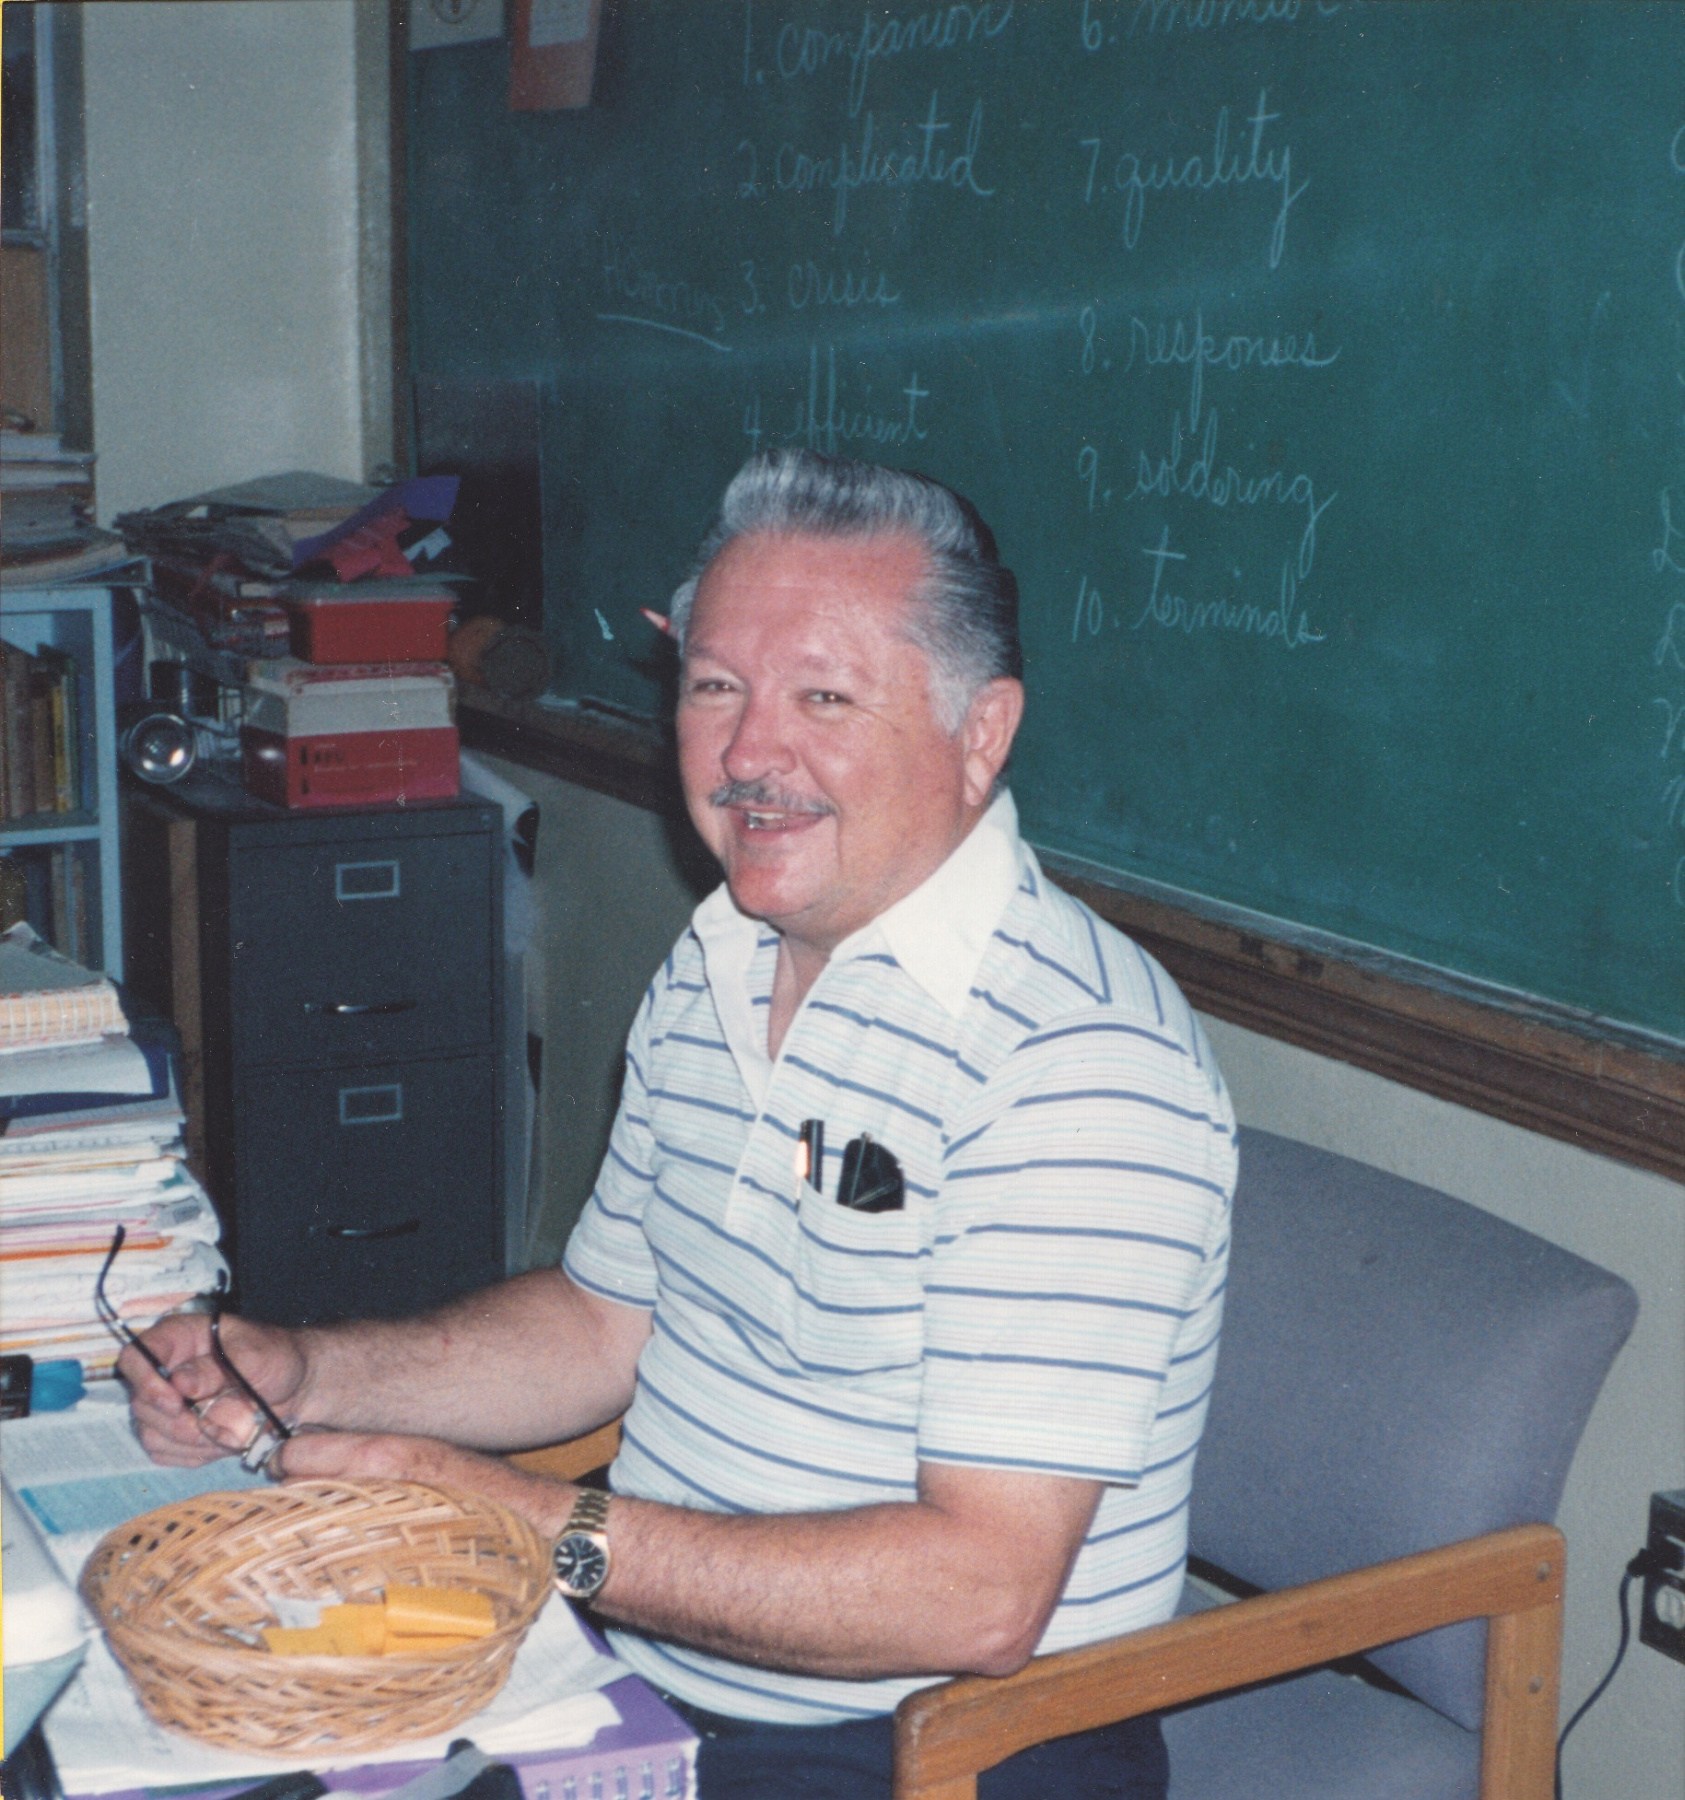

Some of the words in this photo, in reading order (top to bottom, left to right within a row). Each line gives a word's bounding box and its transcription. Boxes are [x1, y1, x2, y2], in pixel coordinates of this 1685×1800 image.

[743, 0, 765, 86] 1.
[776, 0, 1013, 119] companion
[774, 88, 996, 237] complicated
[1079, 137, 1108, 205] 7.
[1115, 86, 1311, 270] quality
[741, 259, 767, 315] 3.
[1079, 305, 1112, 376] 8.
[1123, 303, 1343, 435] responses
[1078, 445, 1113, 514] 9.
[1124, 406, 1339, 581] soldering
[1072, 575, 1120, 644] 10.
[1130, 524, 1328, 650] terminals
